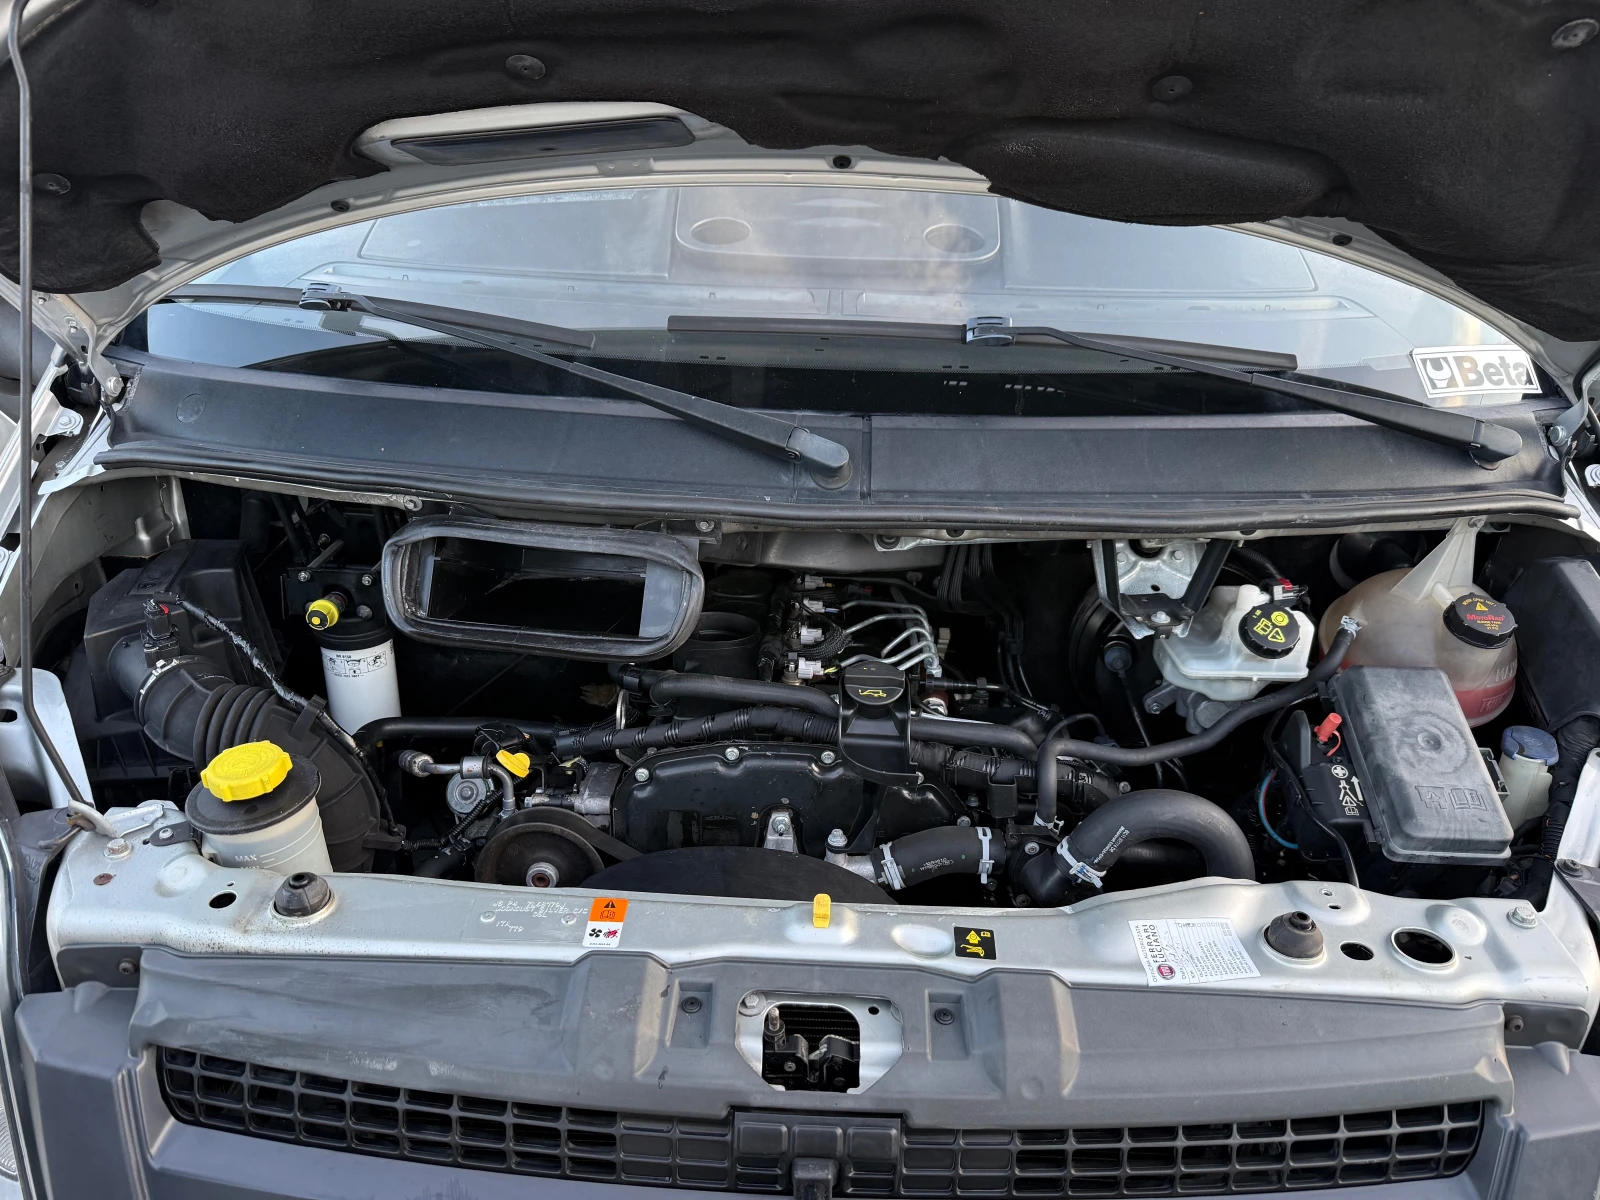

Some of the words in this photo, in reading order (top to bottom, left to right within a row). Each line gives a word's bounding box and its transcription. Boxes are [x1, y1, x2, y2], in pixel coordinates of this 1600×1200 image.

[1453, 355, 1534, 387] Beta
[234, 854, 258, 862] MAX
[1135, 925, 1148, 959] AUTORIZZATA
[1142, 924, 1158, 963] FERRARI
[1149, 924, 1167, 963] LUCIANO
